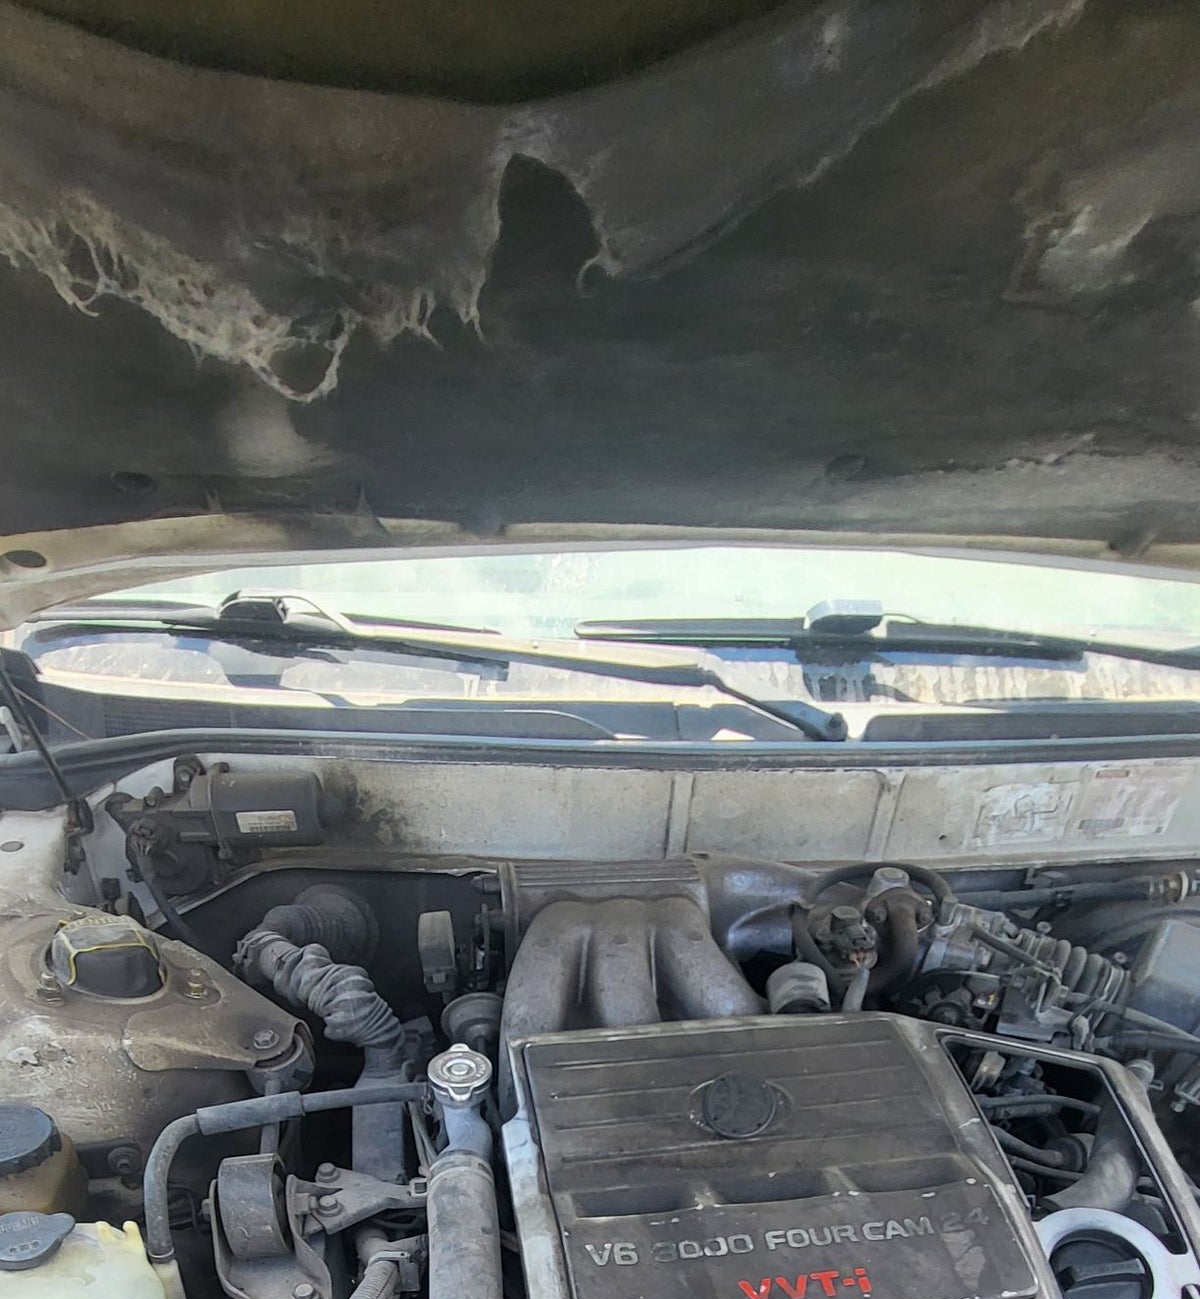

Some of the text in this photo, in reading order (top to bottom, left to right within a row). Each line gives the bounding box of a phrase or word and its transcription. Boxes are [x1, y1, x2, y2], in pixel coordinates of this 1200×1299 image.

[584, 1242, 639, 1266] V6
[764, 1225, 860, 1250] FOUR
[862, 1216, 935, 1242] CAM
[942, 1207, 989, 1233] 24
